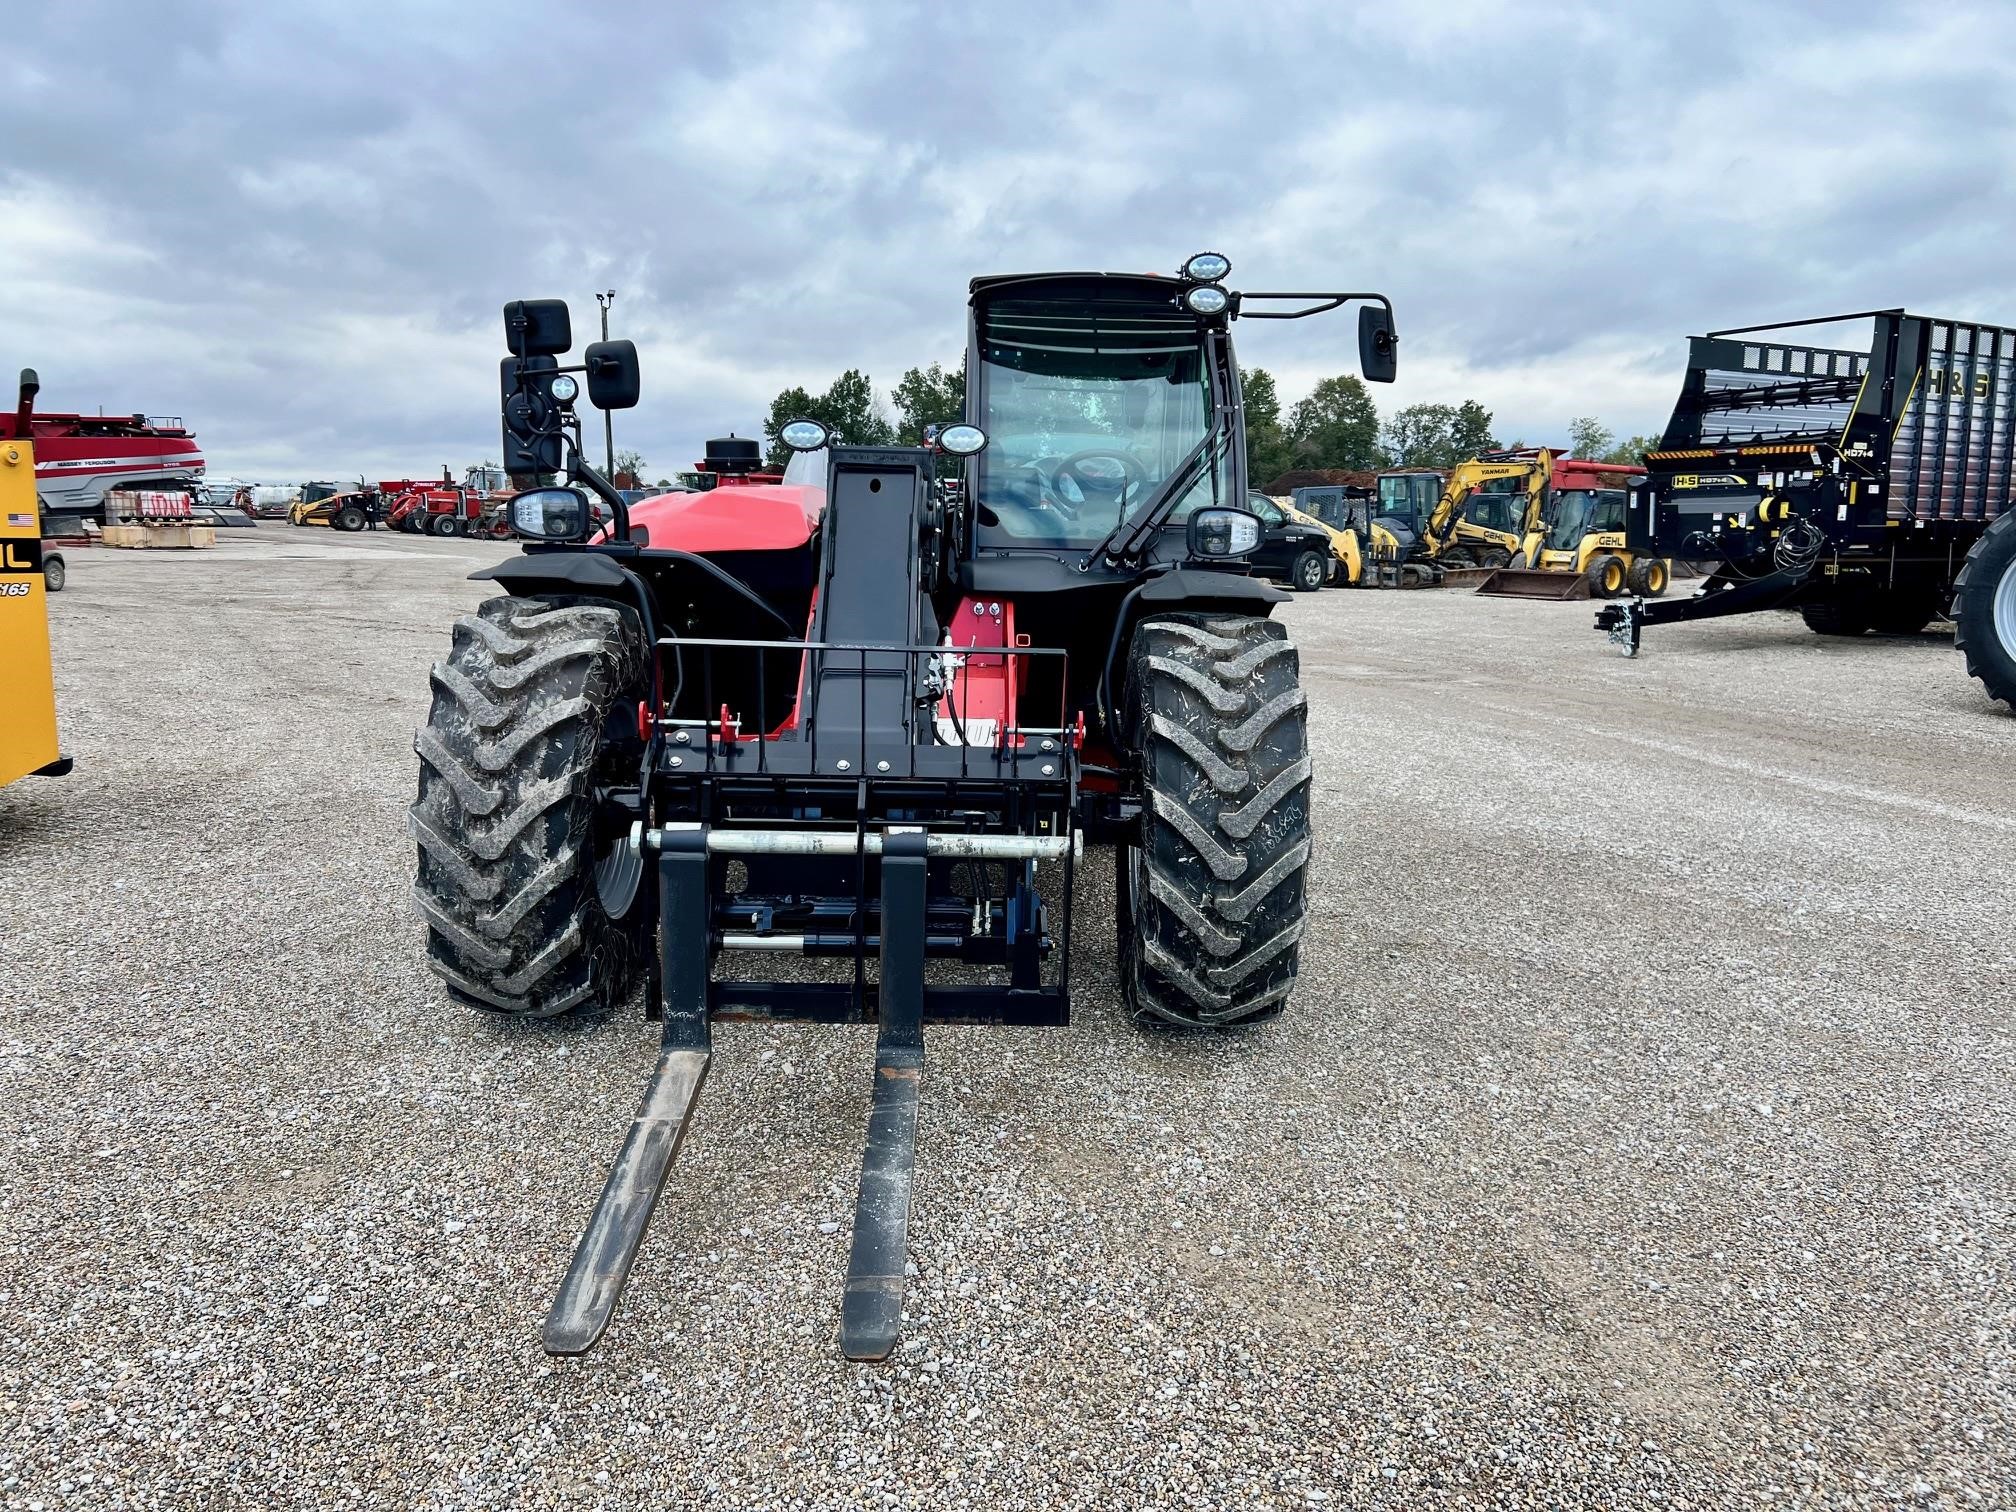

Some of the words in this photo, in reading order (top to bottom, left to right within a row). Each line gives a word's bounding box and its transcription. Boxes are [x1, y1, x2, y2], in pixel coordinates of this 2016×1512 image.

[1483, 530, 1506, 542] GEHL
[1598, 536, 1623, 546] GEHL
[0, 582, 31, 596] 165
